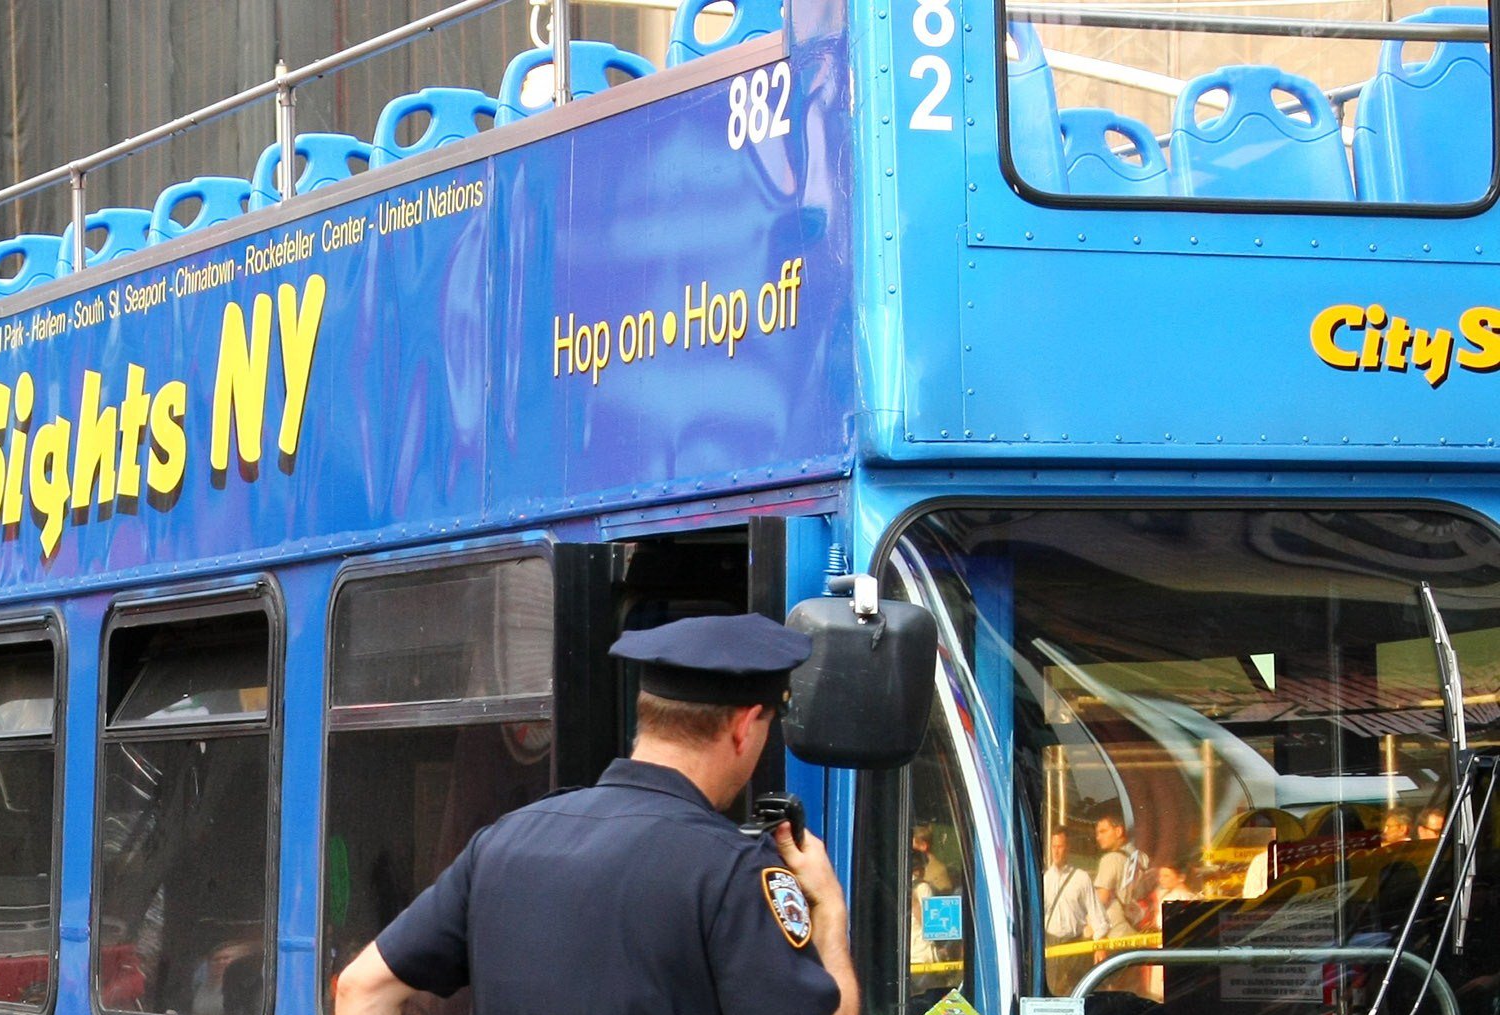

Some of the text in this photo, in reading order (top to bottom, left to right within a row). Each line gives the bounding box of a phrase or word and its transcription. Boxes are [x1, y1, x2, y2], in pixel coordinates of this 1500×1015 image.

[727, 61, 791, 150] 882
[4, 320, 25, 350] Park
[32, 311, 65, 342] Harlem
[73, 296, 104, 329] South
[124, 277, 167, 315] Seaport
[175, 258, 234, 298] Chinatown
[245, 231, 315, 276] Rockefeller
[321, 216, 366, 252] Center
[378, 194, 422, 236] United
[426, 180, 484, 221] Nations
[554, 257, 802, 385] Hop on Hop off
[210, 273, 326, 478] NY
